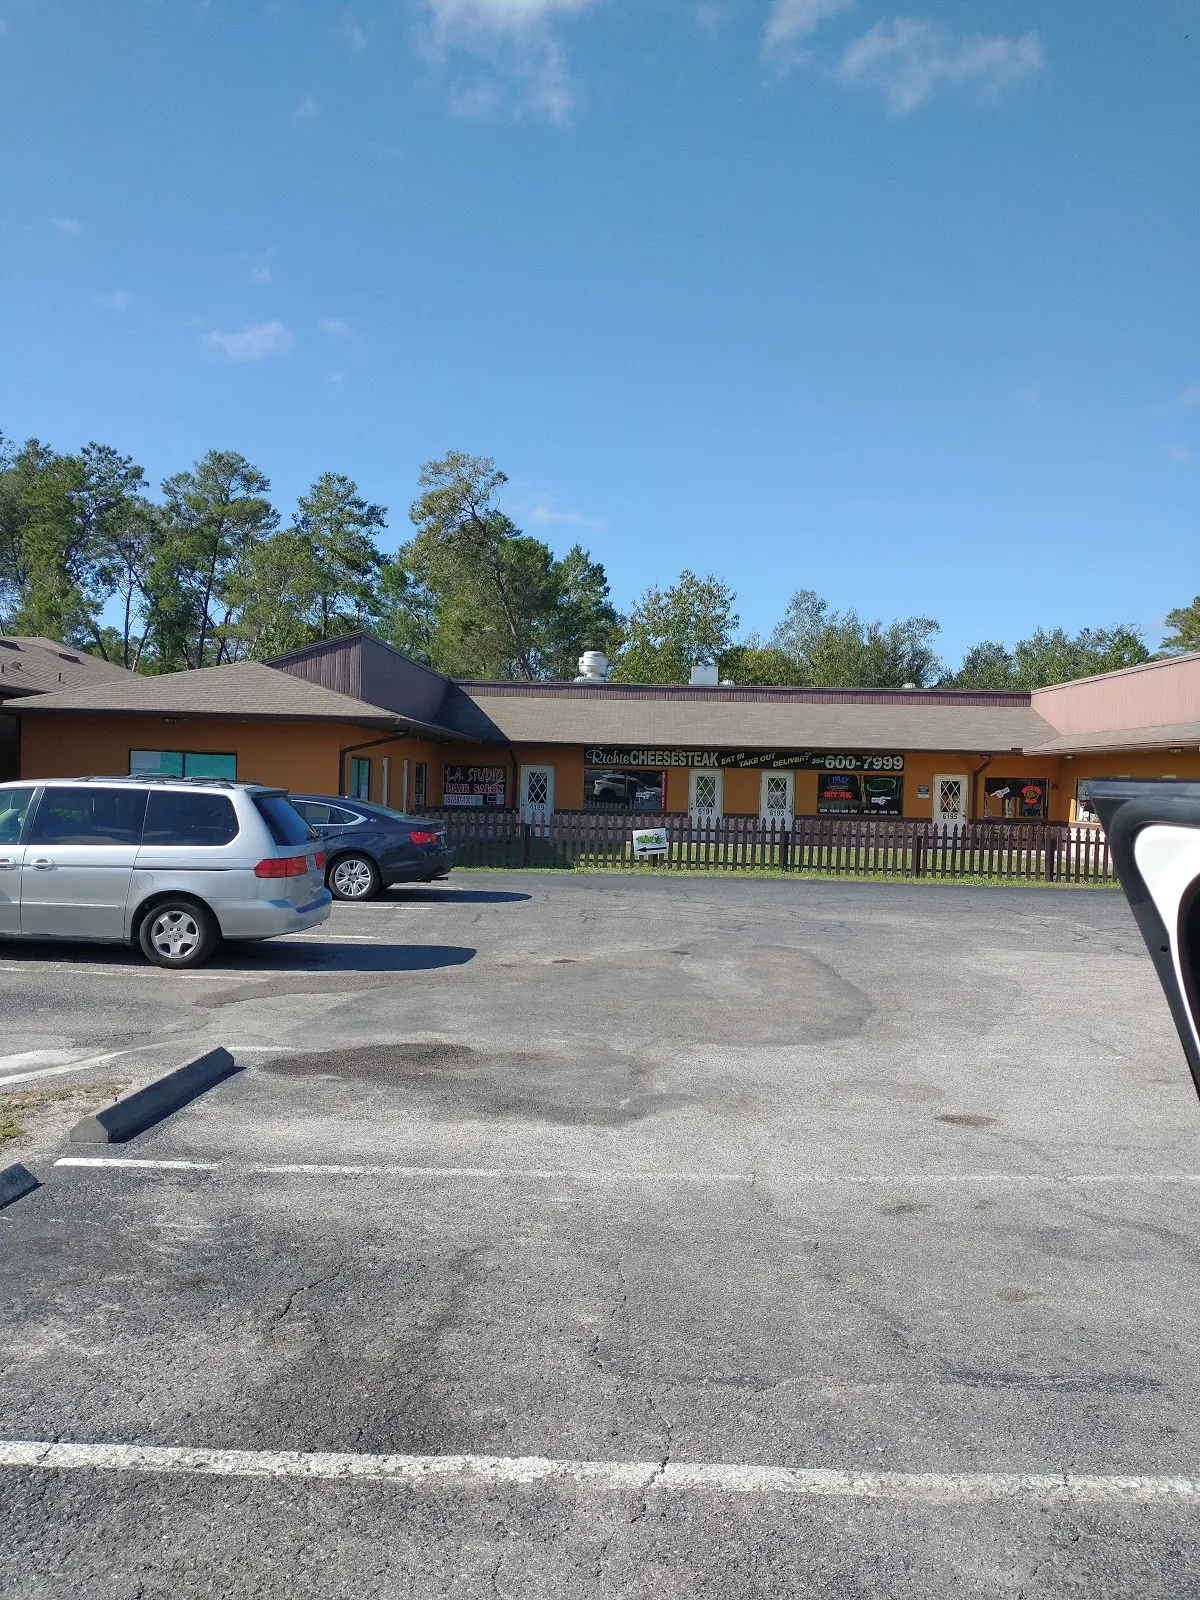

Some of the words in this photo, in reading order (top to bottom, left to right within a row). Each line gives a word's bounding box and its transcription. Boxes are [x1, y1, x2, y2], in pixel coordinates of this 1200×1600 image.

[585, 749, 630, 764] Richie
[629, 750, 719, 767] CHEESESTEAK
[721, 756, 735, 765] EAT
[736, 752, 745, 760] IN
[739, 757, 759, 768] TAKE
[760, 752, 777, 763] OUT
[772, 752, 810, 768] DELIVERY
[811, 757, 825, 765] 352
[824, 755, 904, 770] 600-7999
[467, 767, 504, 782] STUDIO
[445, 783, 470, 794] HAIR
[473, 783, 505, 795] SALON
